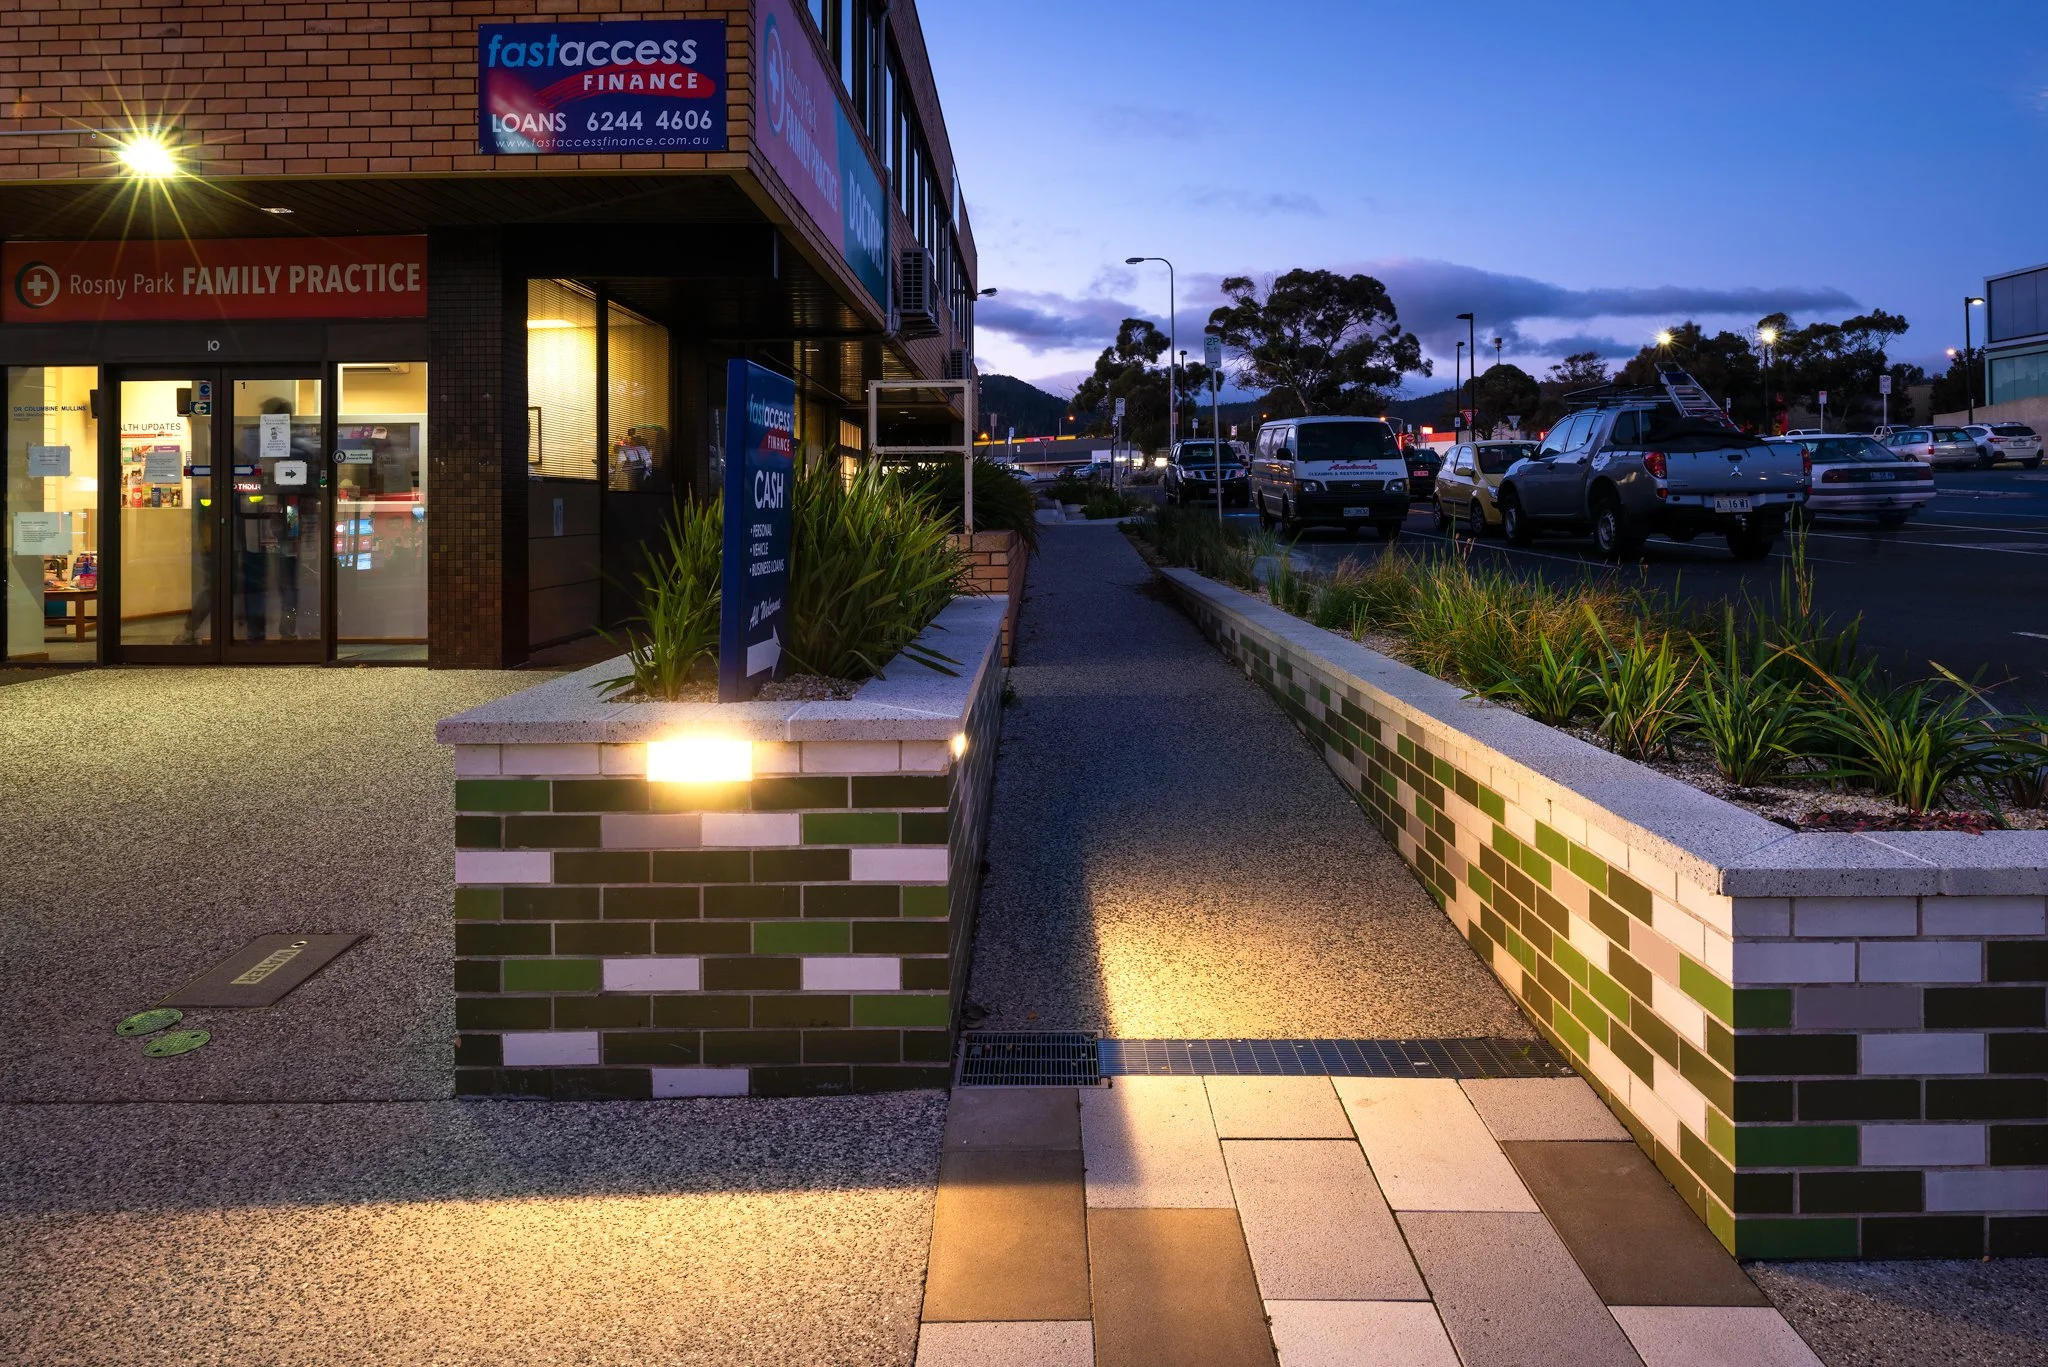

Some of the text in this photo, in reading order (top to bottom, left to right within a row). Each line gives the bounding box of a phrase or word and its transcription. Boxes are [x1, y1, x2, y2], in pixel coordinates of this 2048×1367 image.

[488, 34, 698, 68] fastaccess
[583, 72, 698, 91] FINANCE
[785, 52, 818, 133] Rosny Park
[492, 110, 712, 133] LOANS 6244 4606
[495, 136, 710, 149] www.fastaccessfinance.com.au
[785, 102, 839, 214] FAMILY PRACTICE
[849, 169, 885, 277] DOCTORS
[69, 263, 421, 299] Rosny Park FAMILY PRACTICE
[241, 382, 246, 390] 1
[749, 393, 791, 433] fastaccess
[141, 423, 181, 431] UPDATES
[767, 434, 790, 452] FINANCE
[754, 469, 784, 509] CASH
[752, 523, 773, 538] PERSONAL
[752, 542, 769, 557] VEHICLE
[752, 558, 785, 577] BUSINESS LOANS
[237, 950, 298, 983] WATER
